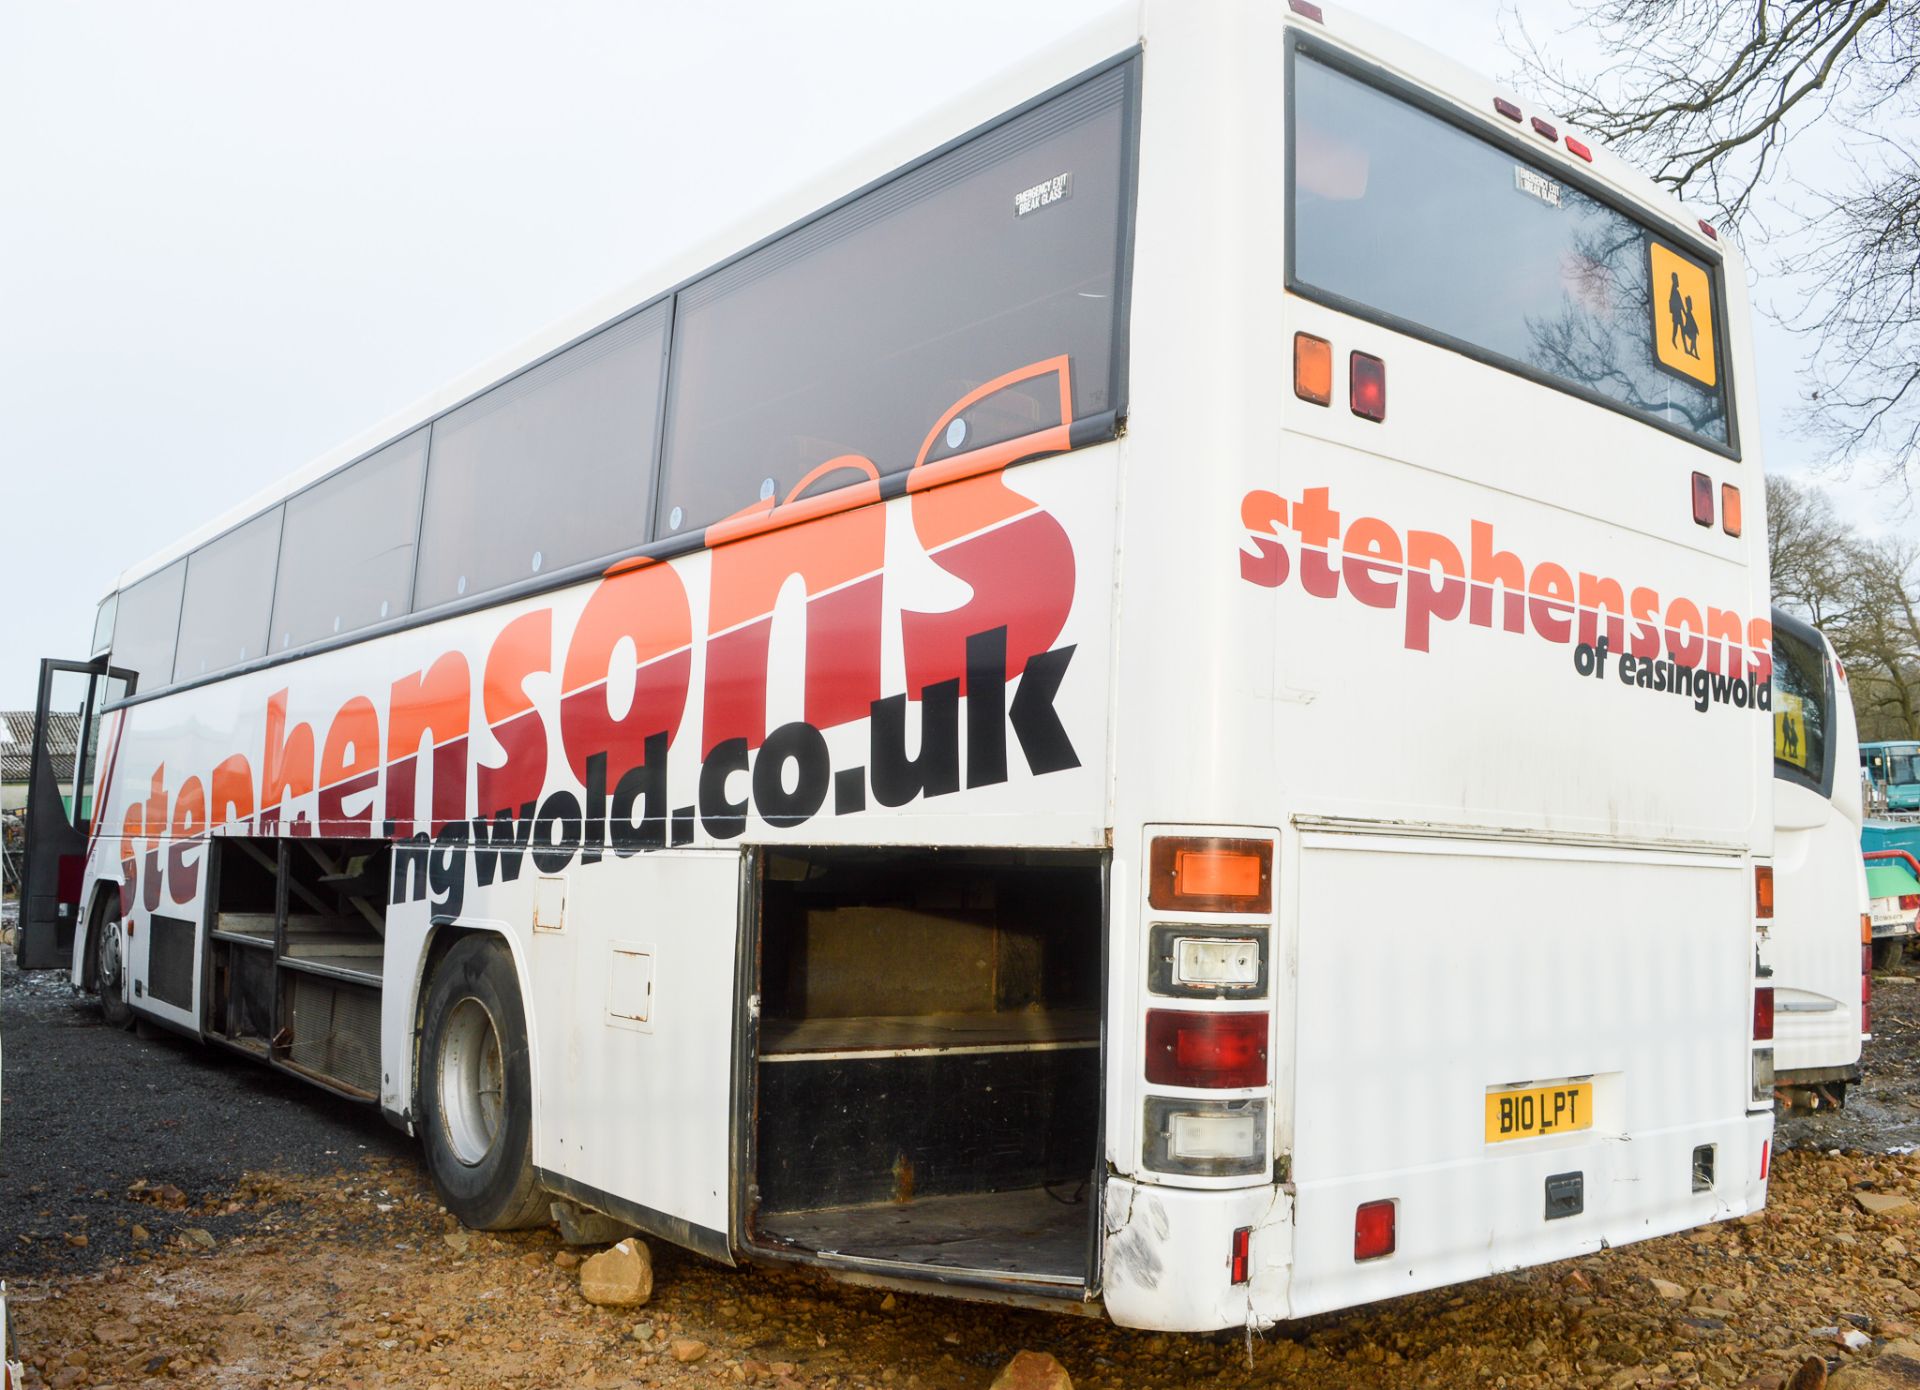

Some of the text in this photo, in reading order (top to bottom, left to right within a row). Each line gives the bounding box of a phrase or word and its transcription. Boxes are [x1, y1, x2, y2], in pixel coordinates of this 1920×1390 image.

[1015, 172, 1068, 206] EMERGENCY EXIT
[1019, 190, 1062, 215] BREAK GLASS
[1239, 486, 1773, 686] stephensons
[119, 353, 1076, 918] stephensons
[1574, 635, 1772, 713] of easingwold
[382, 625, 1082, 926] ngwold.co.uk
[1540, 1089, 1579, 1127] LPT
